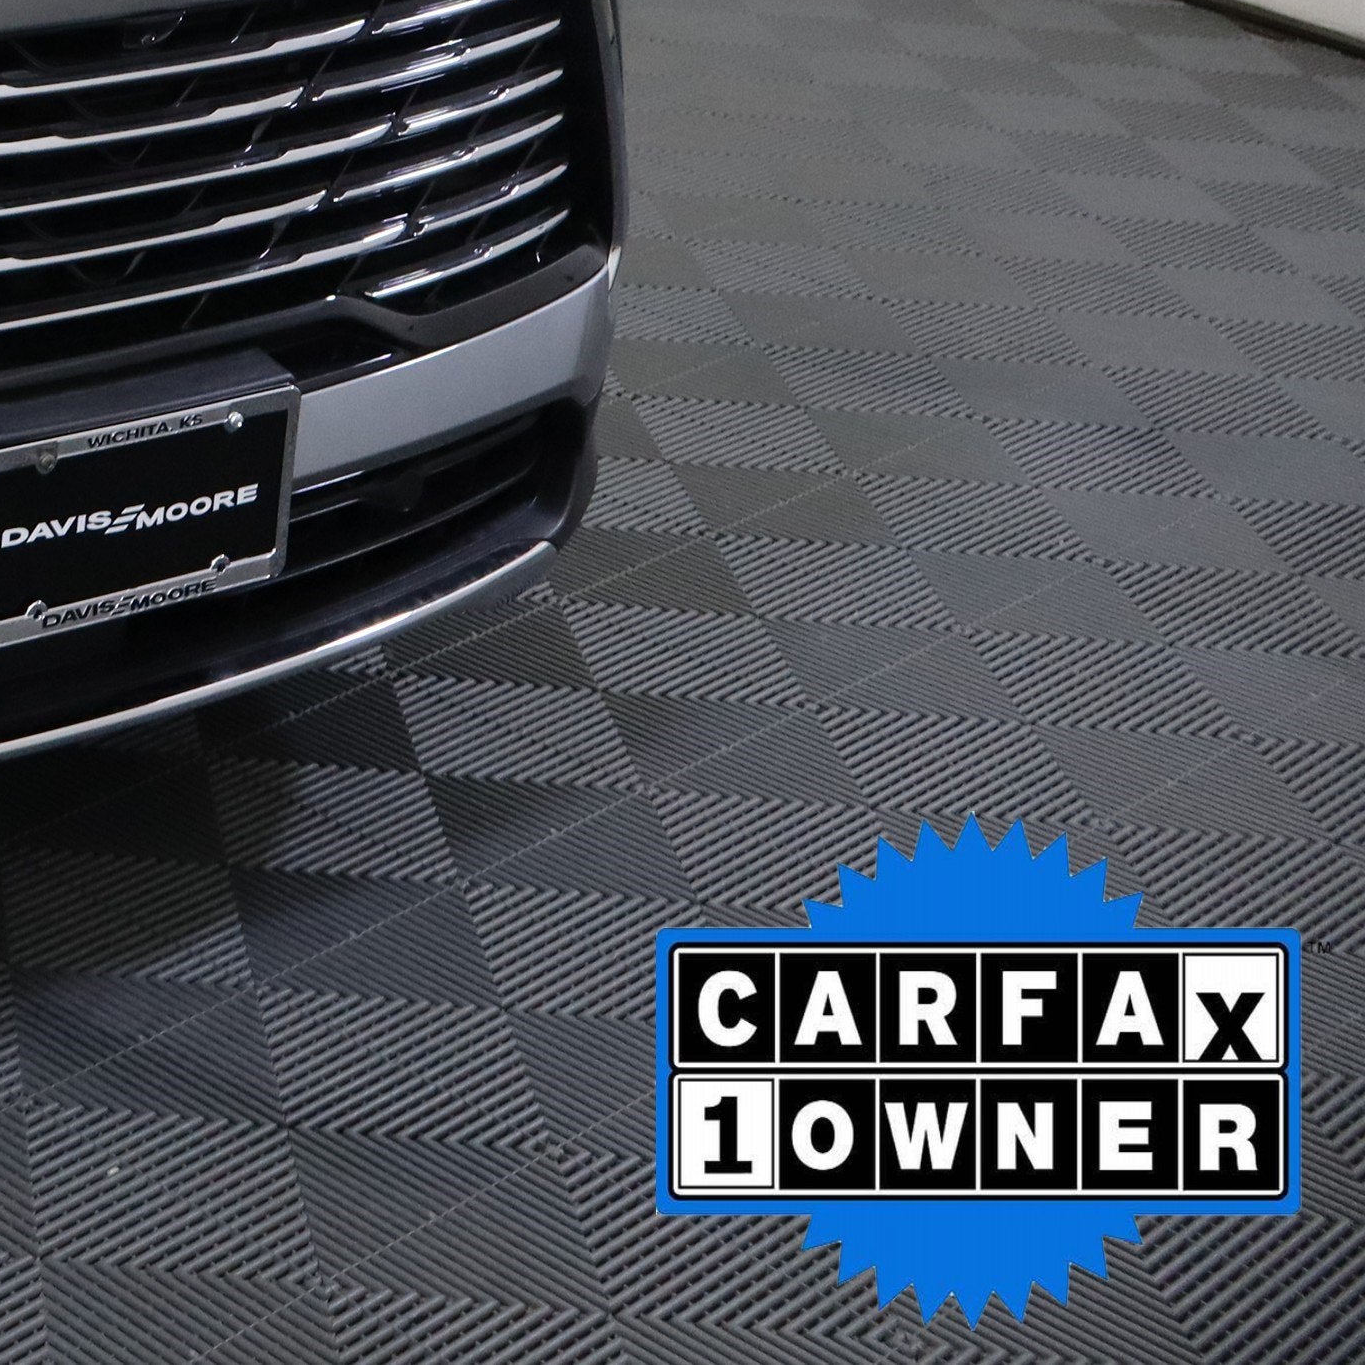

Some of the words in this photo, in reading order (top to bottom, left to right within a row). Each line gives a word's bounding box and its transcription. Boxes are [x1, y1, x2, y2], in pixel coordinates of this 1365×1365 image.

[179, 413, 204, 430] KS
[0, 510, 112, 549] DAVIS
[135, 483, 259, 531] MOORE
[42, 599, 115, 629] DAVIS
[129, 576, 218, 612] MOORE
